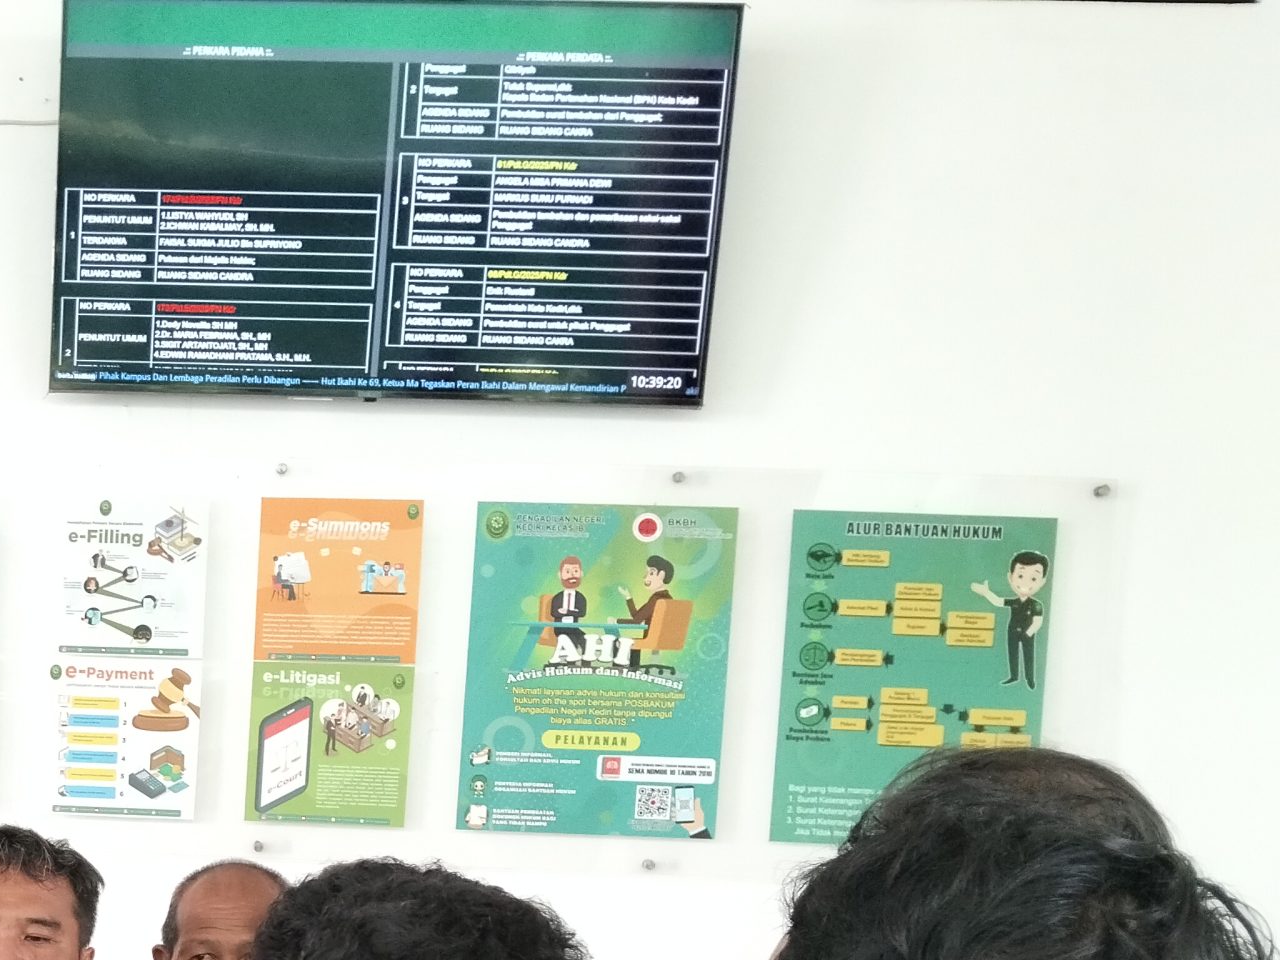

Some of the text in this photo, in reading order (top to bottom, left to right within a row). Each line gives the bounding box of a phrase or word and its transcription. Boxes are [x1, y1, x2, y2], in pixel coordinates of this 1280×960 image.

[192, 46, 264, 56] PERKARA PIDANA
[84, 193, 136, 203] NO PERKARA
[83, 215, 126, 224] PENUNTUT
[82, 254, 146, 262] AGENDA SIDANG
[111, 270, 141, 278] SIDANG
[158, 271, 187, 279] RUANG
[188, 272, 218, 280] SIDANG
[410, 268, 423, 276] NO
[80, 302, 131, 311] NO PERKARA
[79, 333, 121, 341] PENUNTUT
[436, 334, 467, 342] SIDANG
[483, 336, 512, 344] RUANG
[121, 373, 151, 381] Kampus
[170, 374, 203, 384] Lembaga
[205, 375, 240, 383] Peradilan
[264, 376, 300, 386] Dibangun
[337, 378, 356, 386] Ikahi
[383, 379, 404, 387] Ketua
[421, 380, 454, 389] Tegaskan
[457, 380, 479, 388] Peran
[482, 381, 500, 389] Ikahi
[502, 382, 526, 390] Dalam
[529, 382, 568, 392] Mengawal
[570, 384, 619, 392] Kemandirian
[631, 376, 681, 389] 10:39:20
[290, 518, 391, 533] e-Summons
[848, 522, 1003, 540] ALUR BANTUAN HUKUM
[68, 530, 143, 547] e-Filling
[550, 634, 635, 665] AHI
[66, 666, 154, 681] e-Payment
[263, 670, 340, 687] e-Litigasi
[507, 666, 683, 690] Advis Hukum dan Informasi
[512, 687, 542, 695] Nikmati
[543, 688, 574, 697] layanan
[646, 691, 685, 699] konsultasi
[568, 698, 585, 706] spot
[625, 700, 675, 708] POSBAKUM
[515, 706, 558, 715] Pengadilan
[560, 708, 586, 717] Negeri
[614, 709, 636, 718] tanpa
[638, 710, 672, 719] dipungut
[551, 717, 571, 725] biaya
[555, 735, 627, 746] PELAYANAN
[268, 770, 302, 794] e-Court
